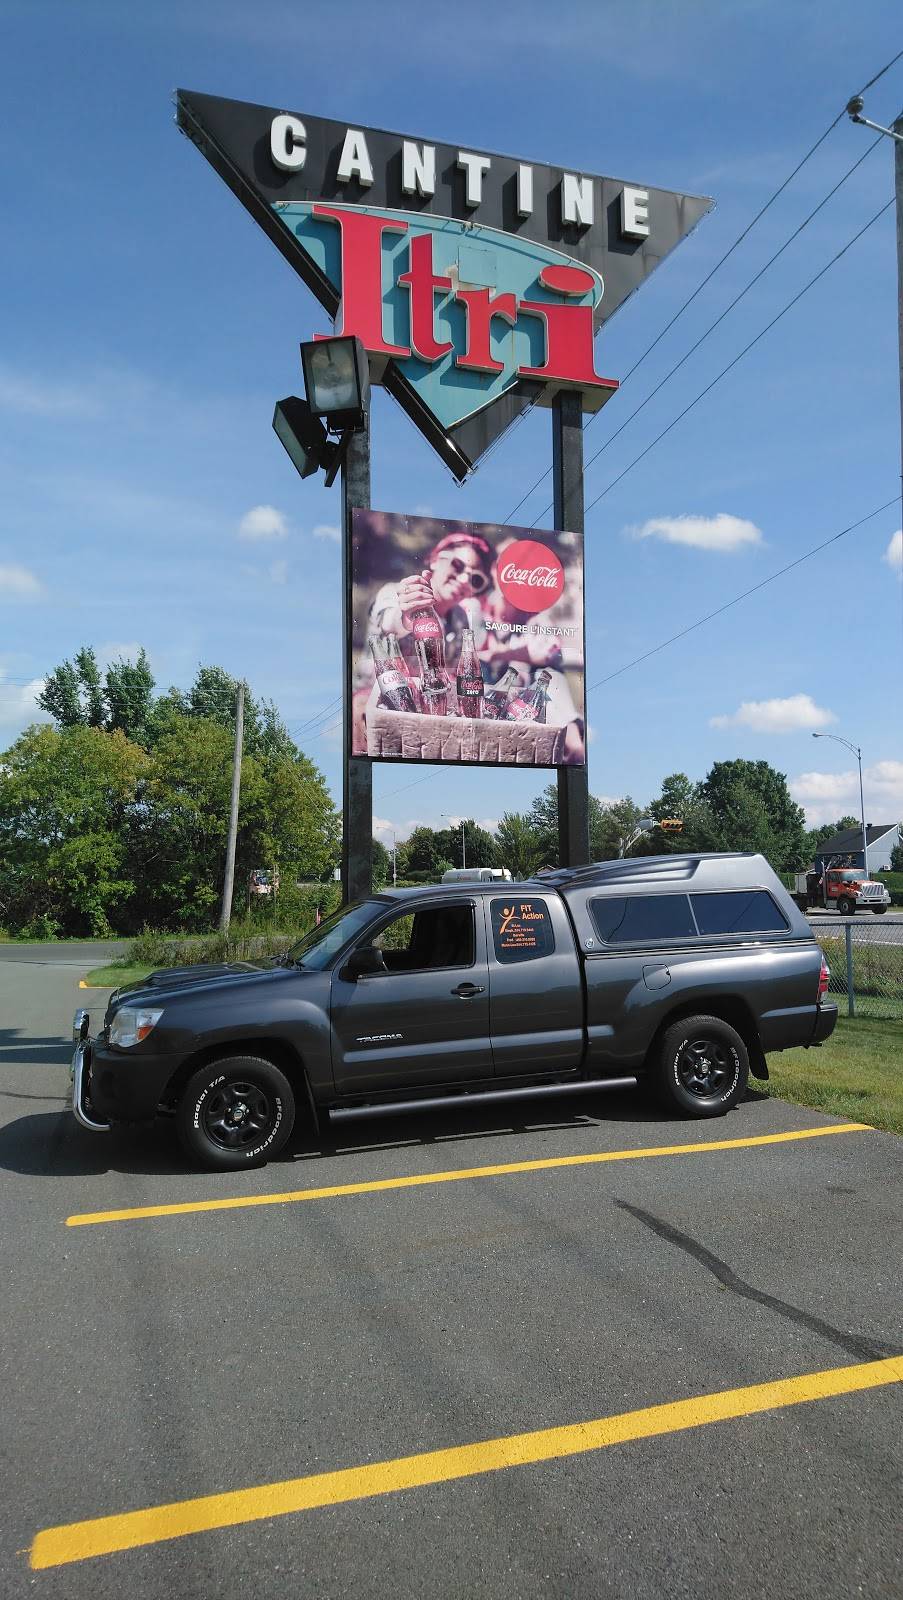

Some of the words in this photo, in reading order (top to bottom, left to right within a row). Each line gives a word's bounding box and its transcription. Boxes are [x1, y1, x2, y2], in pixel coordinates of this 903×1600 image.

[270, 115, 650, 240] CANTINE
[312, 204, 620, 389] Itri
[501, 563, 561, 588] Coca-Cola
[485, 621, 528, 633] SAVOURE
[530, 625, 576, 637] L'INSTANT
[520, 904, 532, 912] FIT
[522, 912, 544, 920] Action
